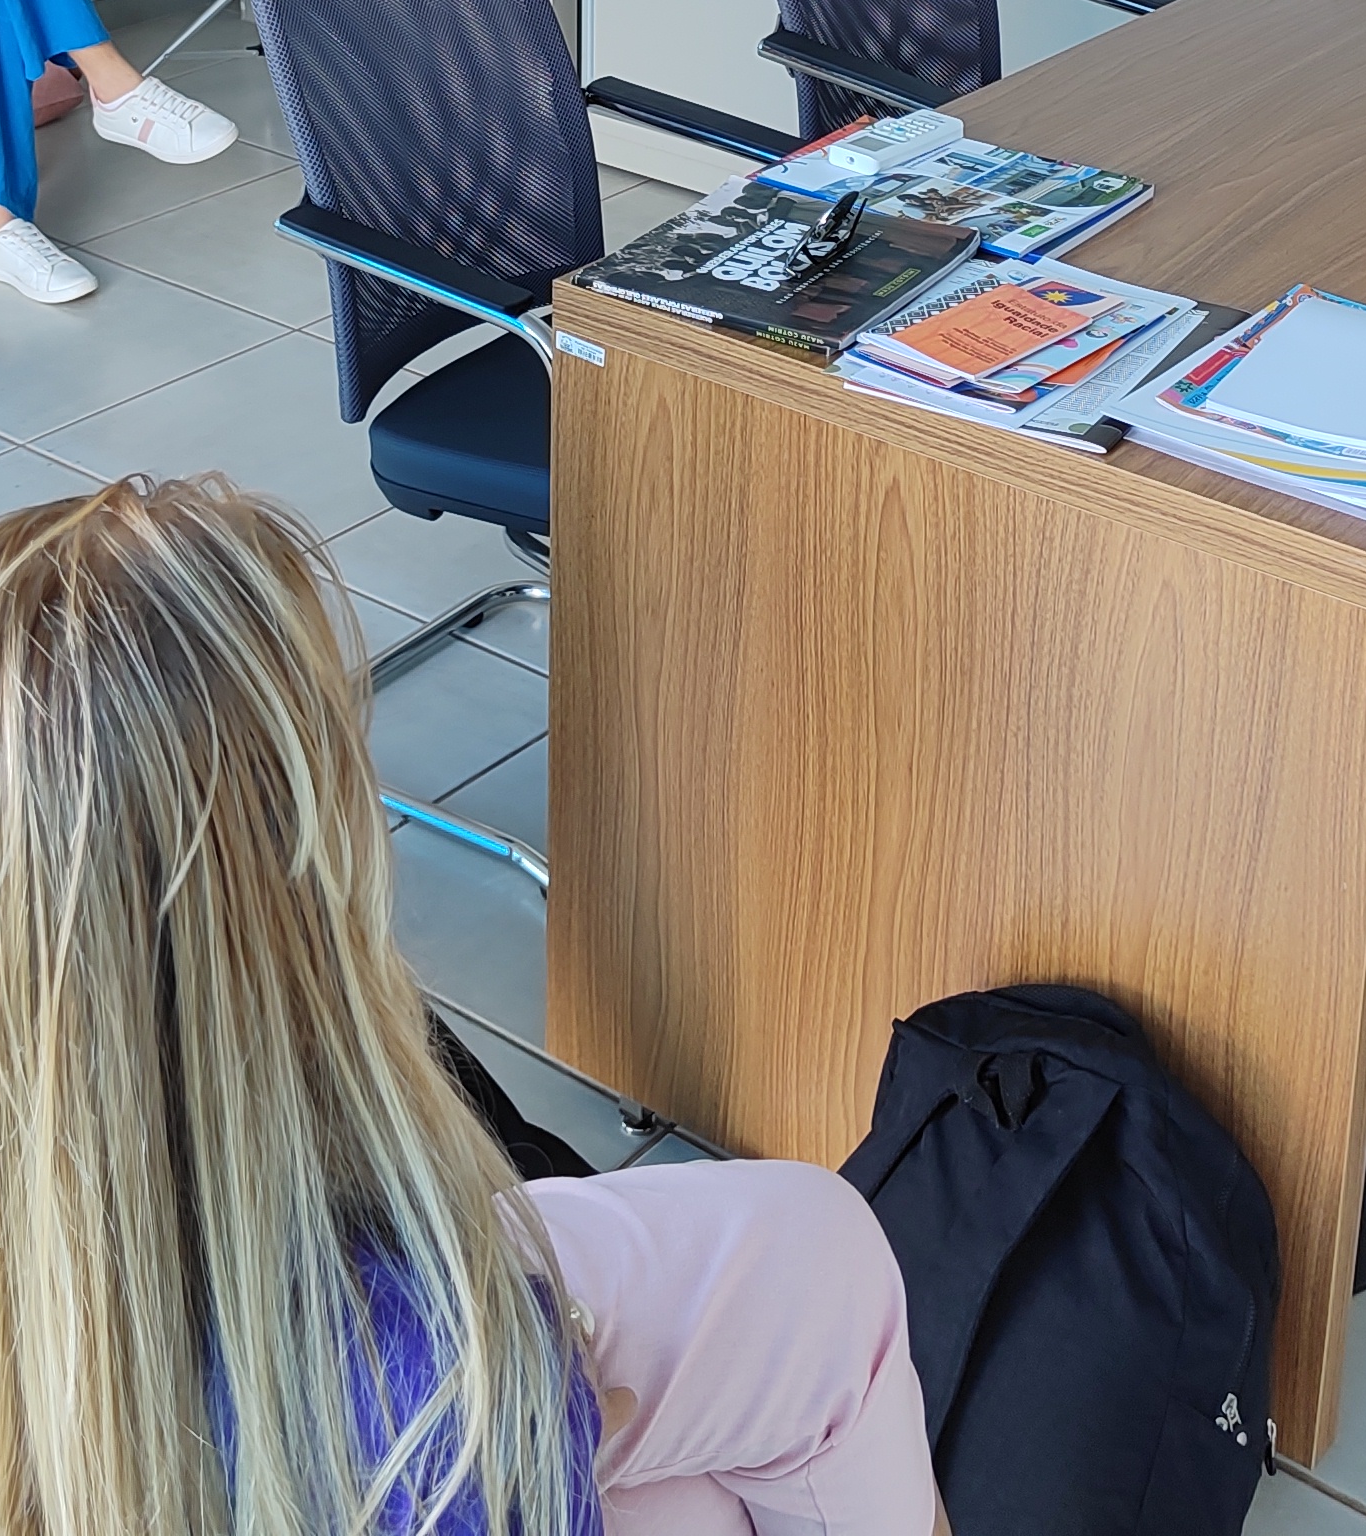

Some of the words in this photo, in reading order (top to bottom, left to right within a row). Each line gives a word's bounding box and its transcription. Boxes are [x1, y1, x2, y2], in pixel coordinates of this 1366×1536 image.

[711, 221, 812, 281] QUILOM
[990, 299, 1060, 334] Igualdade
[1002, 315, 1050, 339] Racial
